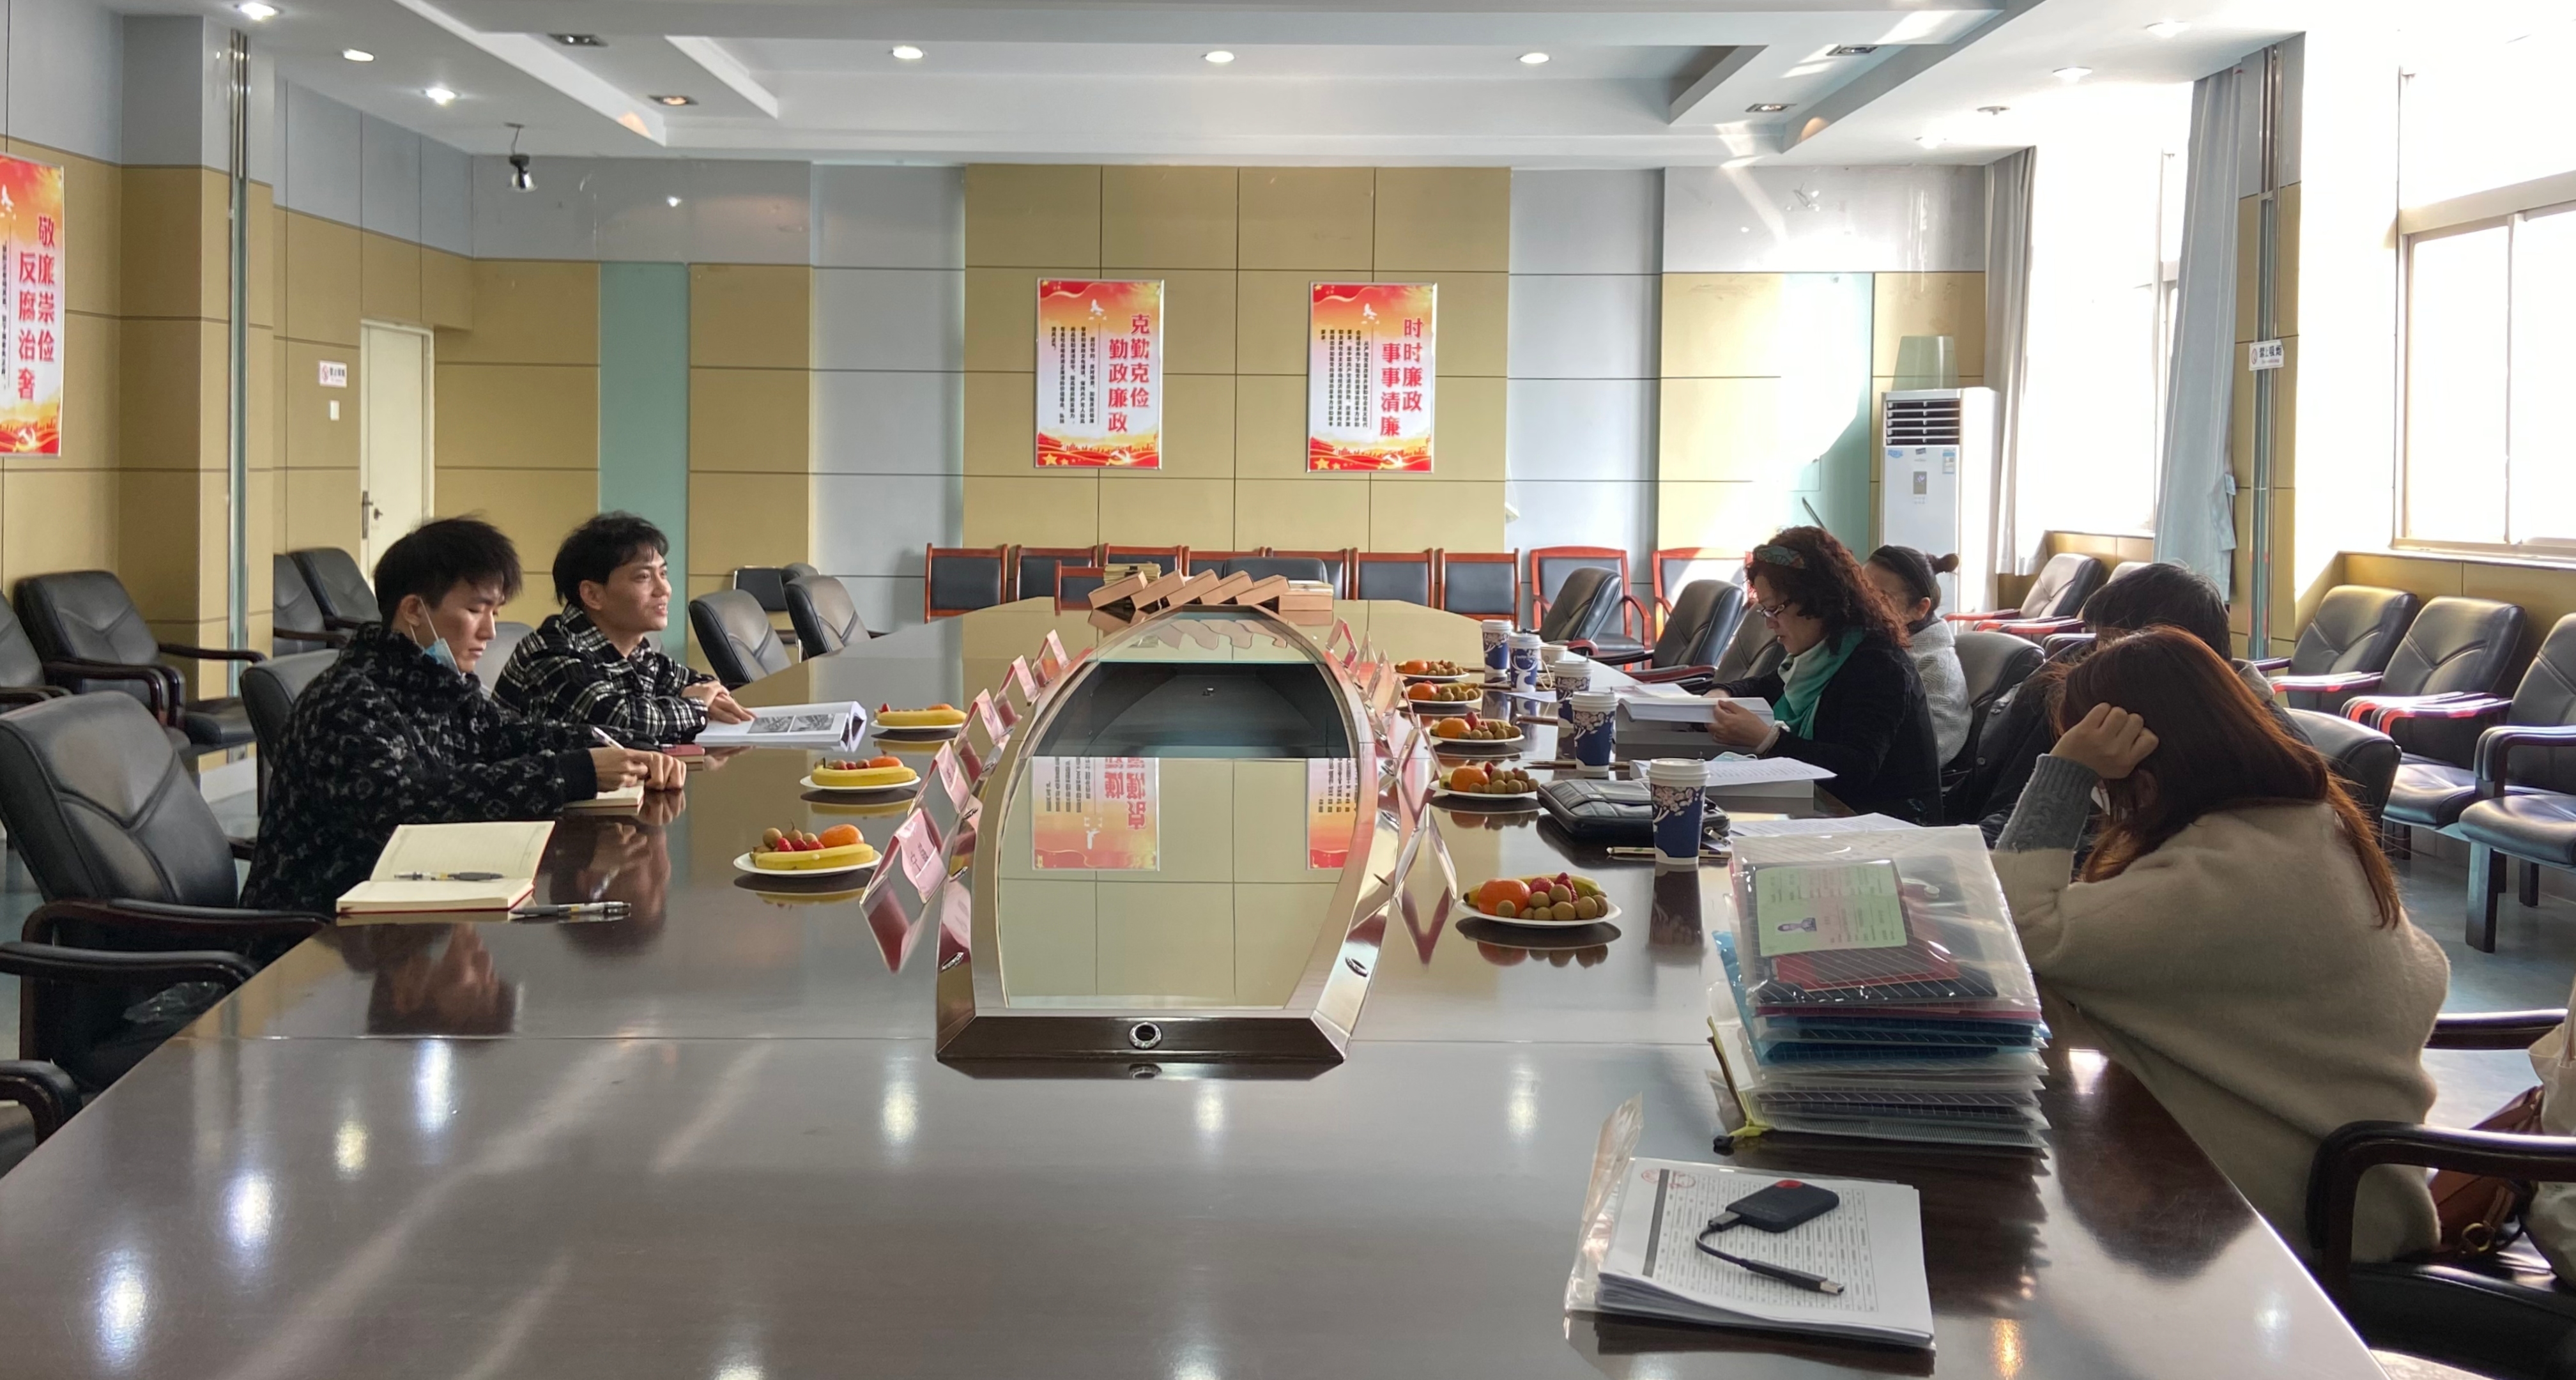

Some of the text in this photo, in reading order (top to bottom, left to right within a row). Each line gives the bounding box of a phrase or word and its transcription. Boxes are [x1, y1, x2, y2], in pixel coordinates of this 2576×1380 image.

[18, 251, 36, 401] 反腐治奢
[38, 215, 55, 362] 敬廉崇俭
[1108, 339, 1128, 433] 勤政廉政
[1130, 314, 1150, 408] 克勤克俭
[1381, 342, 1400, 437] 事事清廉
[1402, 318, 1423, 412] 时时廉政
